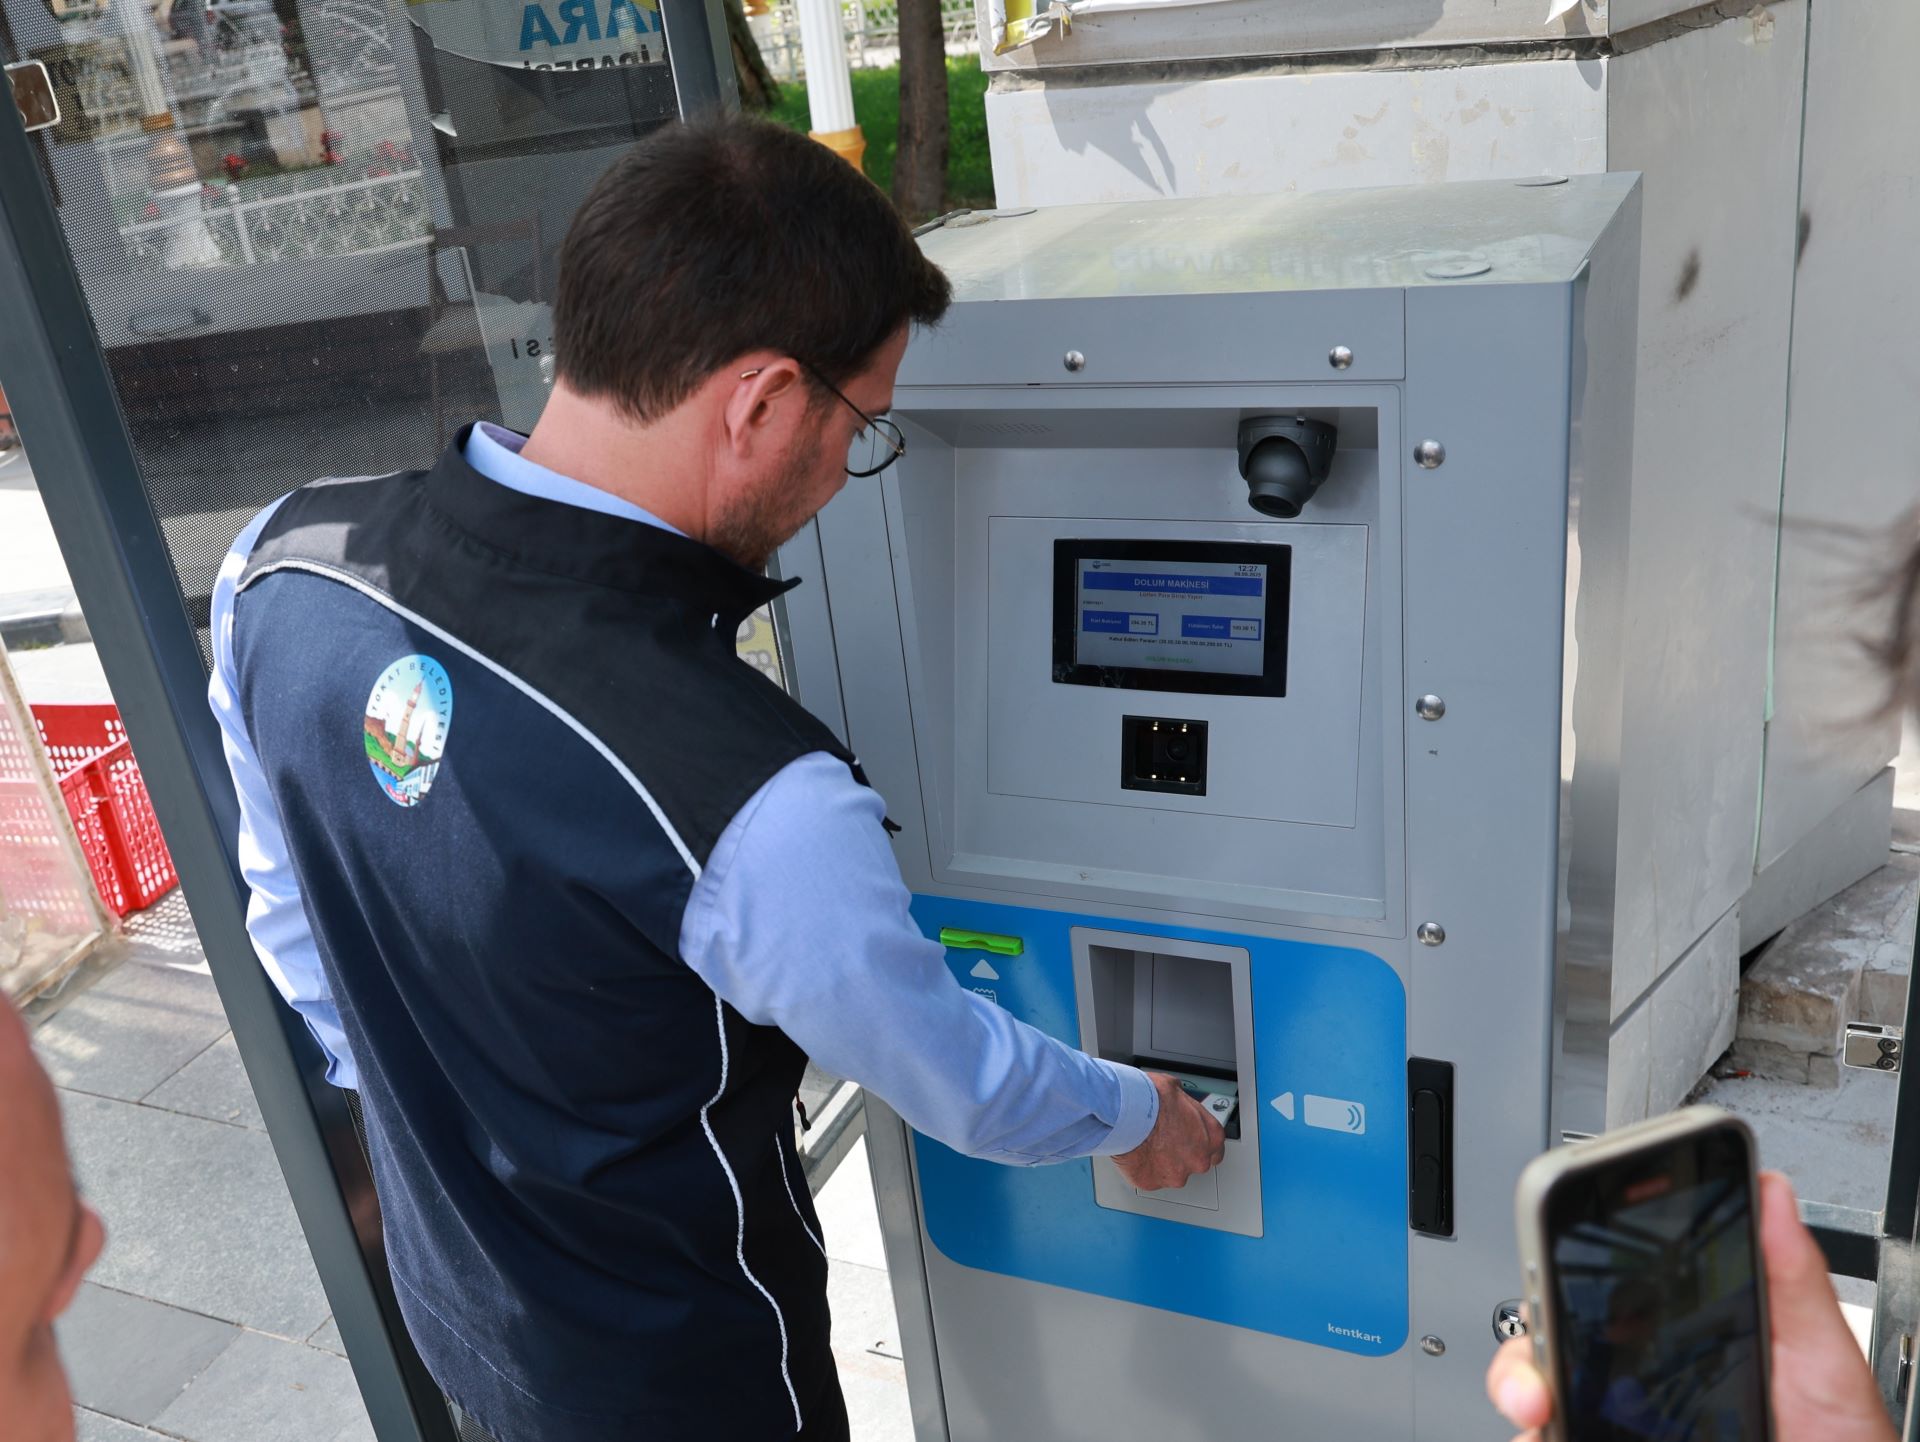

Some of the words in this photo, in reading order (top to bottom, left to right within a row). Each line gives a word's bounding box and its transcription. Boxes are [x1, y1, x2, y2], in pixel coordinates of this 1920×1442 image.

[1134, 578, 1165, 587] DOLUM
[1167, 579, 1209, 589] MAKİNESİ
[371, 668, 401, 712] TOKAT
[1327, 1322, 1382, 1344] kentkart
